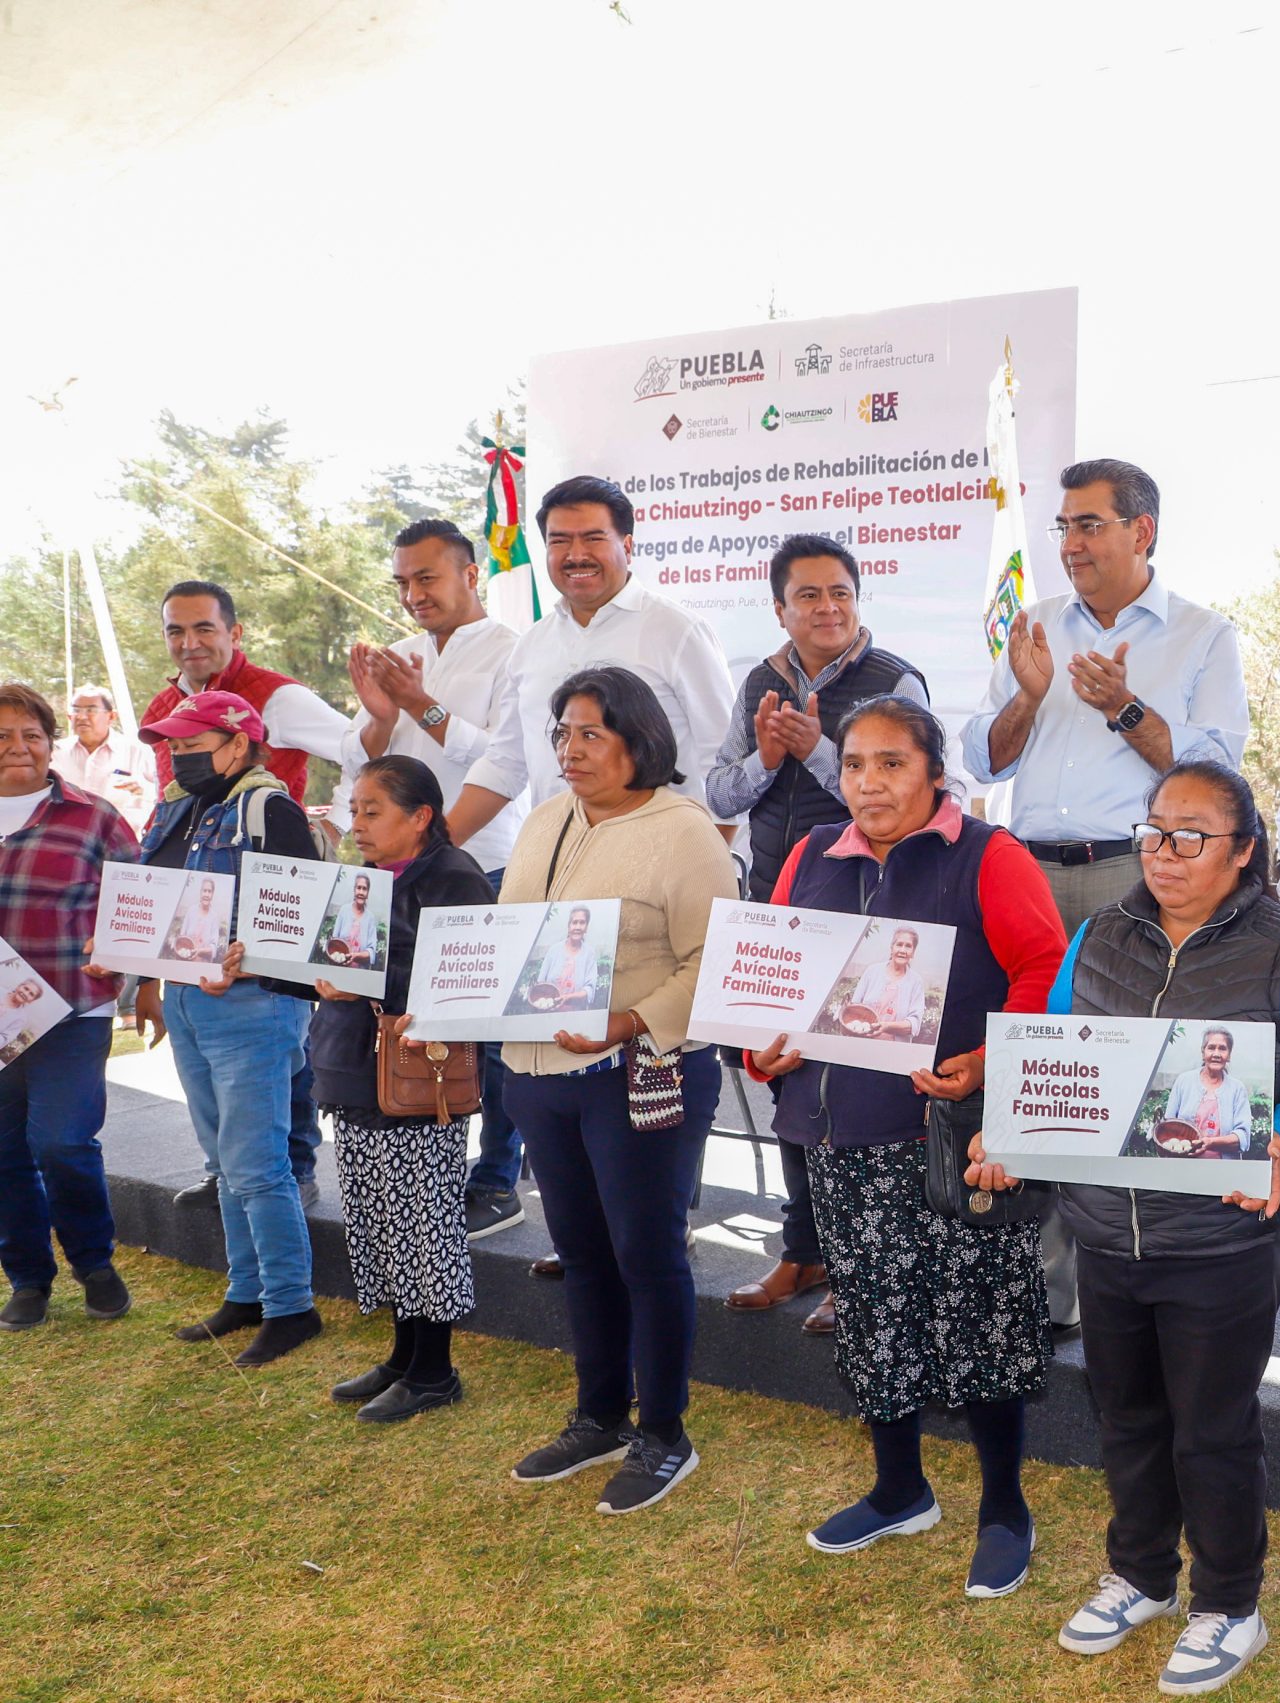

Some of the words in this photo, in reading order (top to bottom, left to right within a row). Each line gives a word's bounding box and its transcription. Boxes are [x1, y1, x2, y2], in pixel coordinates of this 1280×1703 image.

[839, 342, 893, 358] Secretaría
[680, 349, 765, 379] PUEBLA
[839, 360, 852, 372] de
[855, 352, 935, 371] Infraestructura
[680, 378, 690, 389] Un
[692, 375, 727, 391] gobierno
[728, 371, 765, 387] presente
[872, 392, 898, 407] PUE
[686, 415, 729, 429] Secretaría
[872, 406, 898, 423] BLA
[686, 428, 698, 440] de
[699, 425, 738, 439] Bienestar
[624, 476, 647, 493] de
[651, 474, 675, 491] los
[679, 465, 761, 491] Trabajos
[766, 464, 789, 482] de
[794, 449, 946, 480] Rehabilitación
[951, 449, 978, 468] de
[649, 497, 762, 521] Chiautzingo
[780, 492, 817, 512] San
[822, 487, 883, 513] Felipe
[681, 536, 704, 554] de
[708, 534, 779, 558] Apoyos
[835, 526, 853, 545] el
[857, 523, 961, 544] Bienestar
[658, 567, 680, 584] de
[684, 565, 711, 583] las
[715, 560, 771, 582] Famil
[117, 893, 154, 908] Módulos
[259, 888, 301, 905] Módulos
[115, 906, 153, 921] Avícolas
[258, 903, 300, 920] Avícolas
[447, 915, 474, 924] PUEBLA
[744, 912, 777, 923] PUEBLA
[109, 920, 156, 935] Familiares
[253, 917, 305, 936] Familiares
[441, 942, 496, 956] Módulos
[736, 941, 802, 963] Módulos
[438, 958, 494, 973] Avícolas
[731, 959, 800, 981] Avícolas
[430, 976, 499, 990] Familiares
[722, 975, 806, 1001] Familiares
[1026, 1025, 1064, 1035] PUEBLA
[1095, 1029, 1124, 1037] Secretaría
[1022, 1058, 1100, 1079] Módulos
[1020, 1079, 1100, 1100] Avícolas
[1012, 1100, 1110, 1121] Familiares
